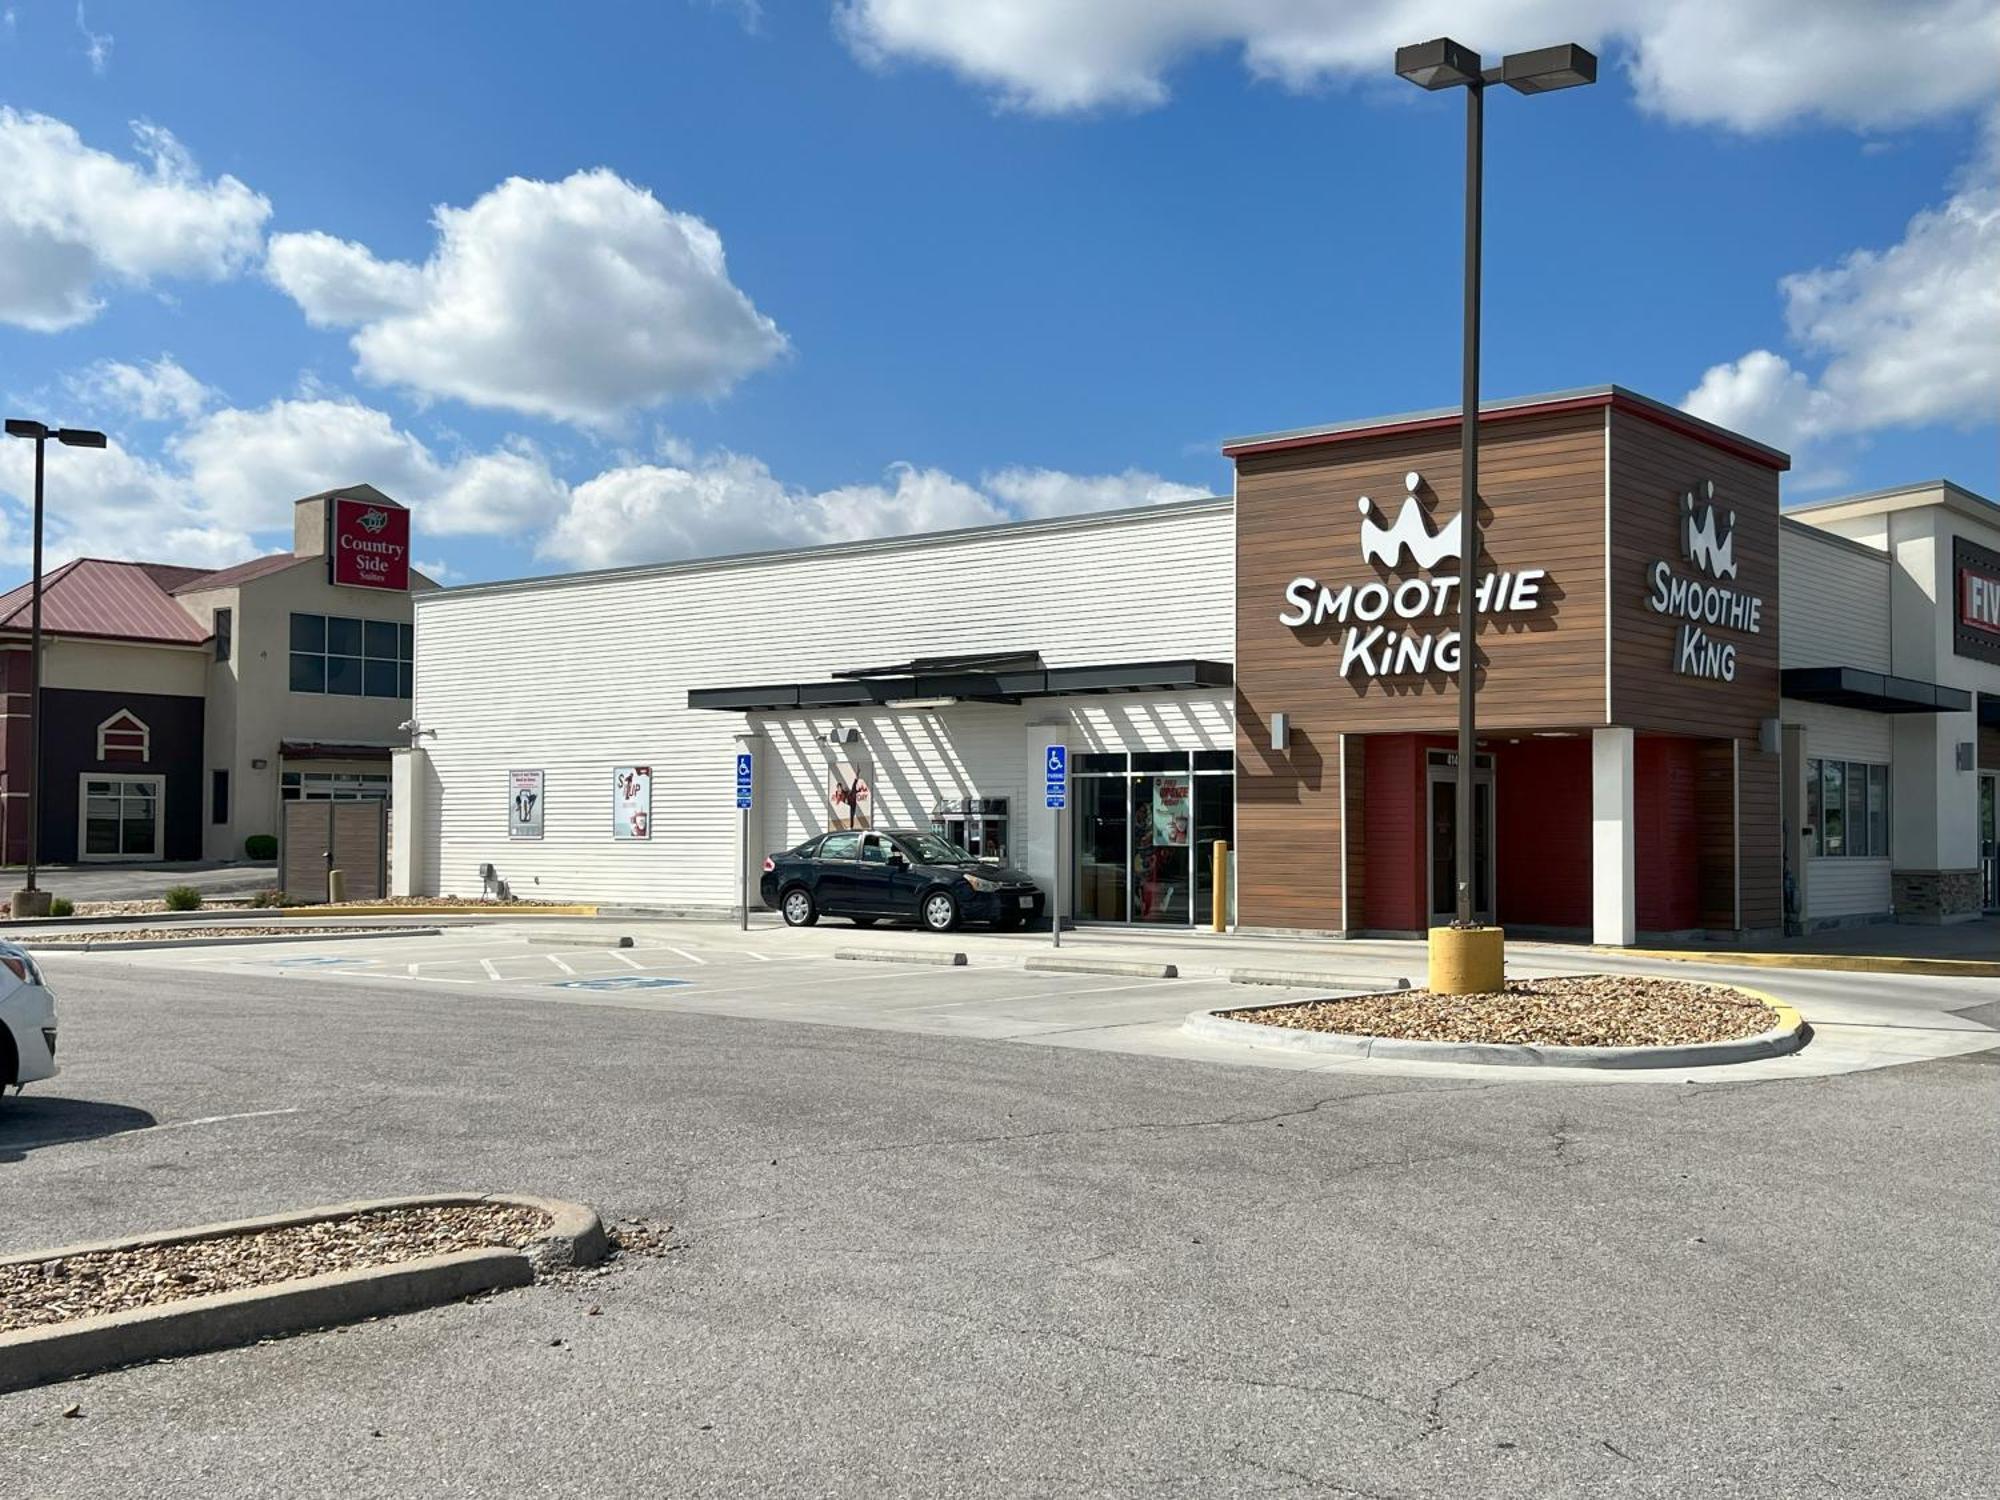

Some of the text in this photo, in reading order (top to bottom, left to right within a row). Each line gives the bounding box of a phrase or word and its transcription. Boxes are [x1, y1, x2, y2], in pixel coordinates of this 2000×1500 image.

[341, 534, 404, 560] Country
[356, 554, 389, 573] Side
[1279, 569, 1545, 627] SMOOTHIE
[1652, 561, 1762, 633] SMOOTHIE
